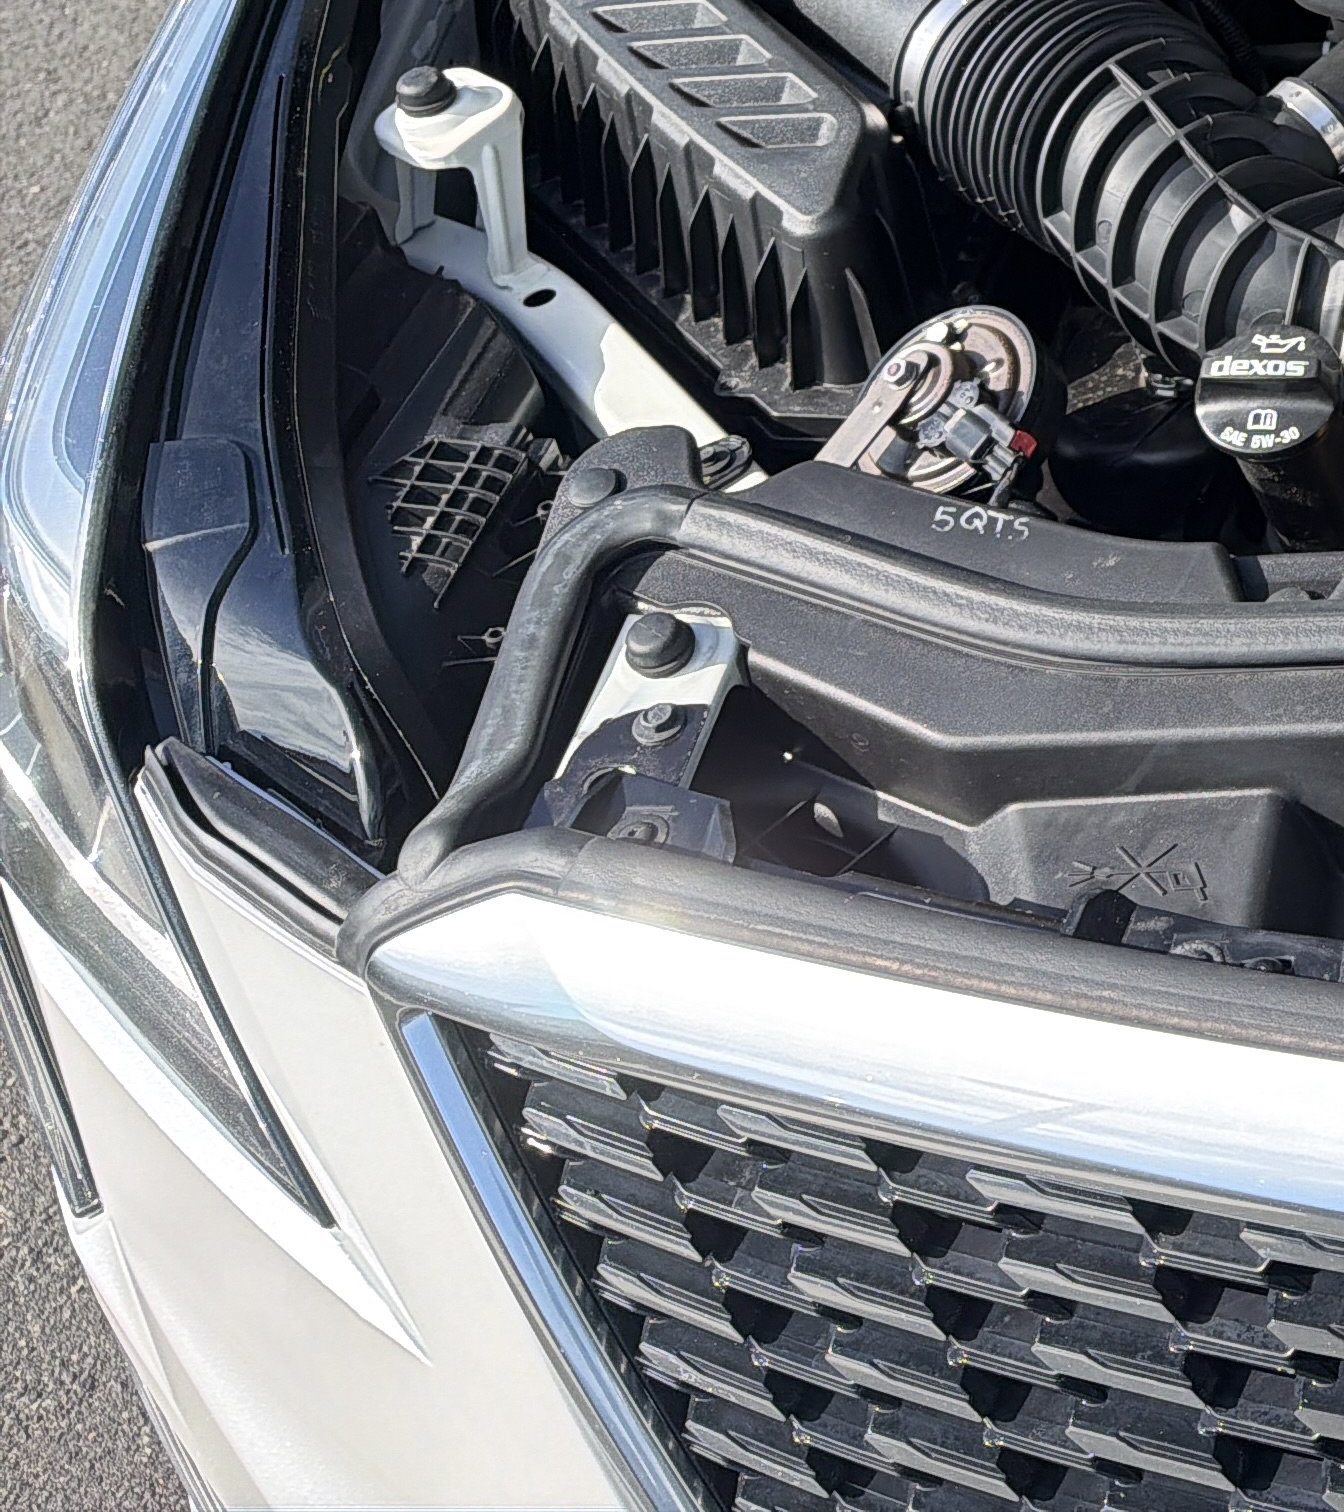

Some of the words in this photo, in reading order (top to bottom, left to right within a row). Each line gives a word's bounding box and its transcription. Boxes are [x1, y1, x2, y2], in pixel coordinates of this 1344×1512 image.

[1210, 355, 1310, 377] dexos
[1220, 426, 1248, 447] SAE
[1250, 426, 1300, 449] 5W-30
